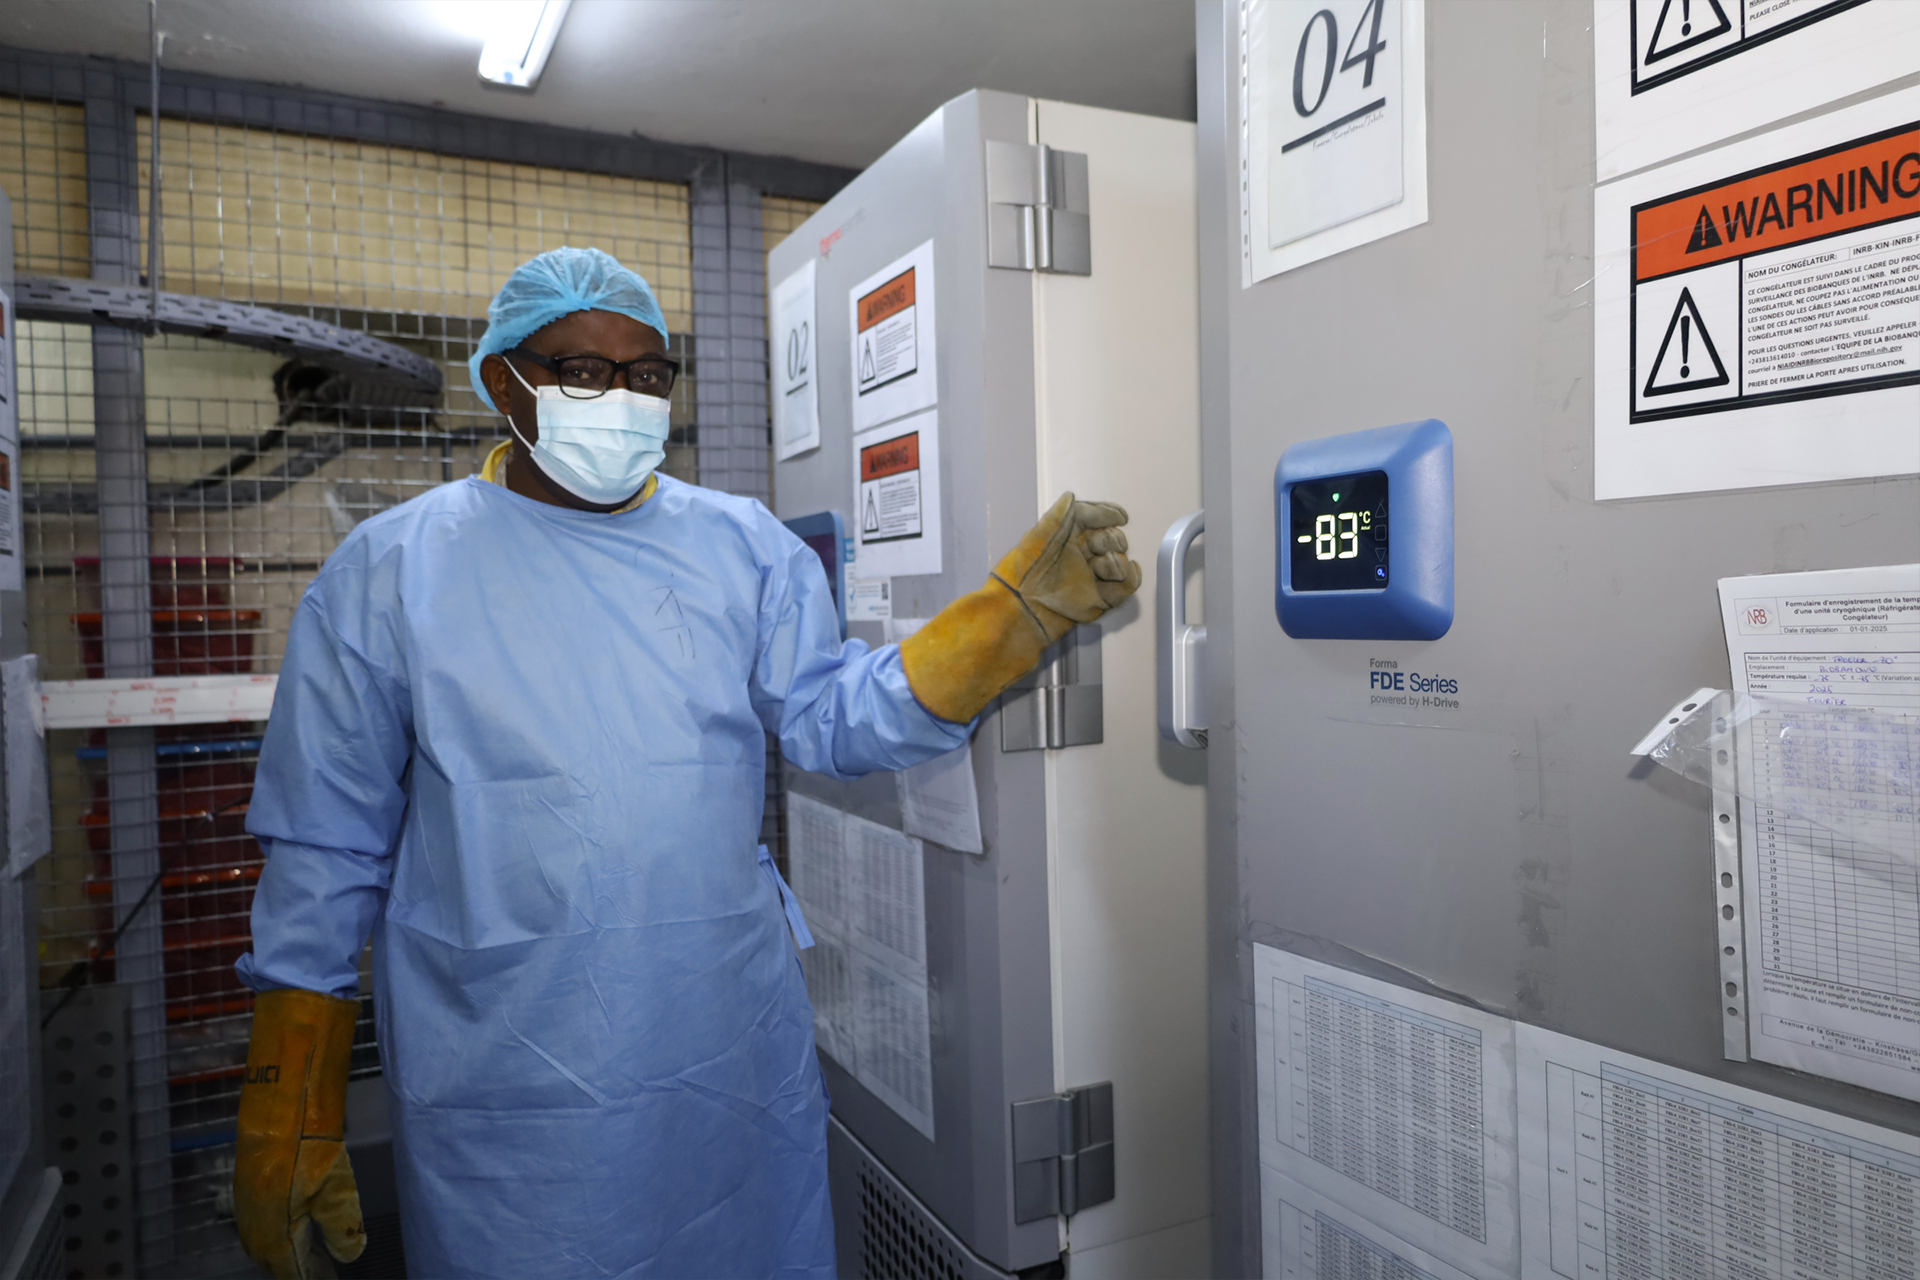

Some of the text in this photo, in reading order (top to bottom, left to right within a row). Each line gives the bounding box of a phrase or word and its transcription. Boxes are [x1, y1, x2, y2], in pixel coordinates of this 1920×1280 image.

[1292, 0, 1386, 118] 04
[1722, 151, 1920, 242] WARNING
[1748, 269, 1766, 278] NOM
[1768, 266, 1779, 274] DU
[1803, 276, 1813, 284] EST
[1815, 272, 1832, 281] SUIVI
[1834, 267, 1852, 277] DANS
[1854, 265, 1861, 273] LE
[1863, 260, 1886, 271] CADRE
[1888, 257, 1899, 266] DU
[1747, 290, 1791, 305] SURVEILLANCE
[1794, 287, 1805, 295] DES
[1807, 278, 1849, 293] BIOBANQUES
[1890, 267, 1899, 275] NE
[1805, 292, 1830, 302] COUPEZ
[1832, 289, 1845, 297] PAS
[1847, 276, 1905, 294] L'ALIMENTATION
[1907, 274, 1918, 282] OU
[1747, 324, 1764, 332] L'UNE
[1776, 319, 1787, 327] CES
[1789, 314, 1815, 324] ACTIONS
[1818, 311, 1833, 319] PEUT
[1836, 306, 1857, 316] AVOIR
[1858, 302, 1878, 312] POUR
[1759, 311, 1783, 321] SONDES
[1785, 308, 1795, 316] OU
[1796, 306, 1806, 314] LES
[1833, 297, 1850, 307] SANS
[1852, 292, 1880, 303] ACCORD
[1747, 347, 1764, 355] POUR
[1778, 338, 1813, 351] QUESTIONS
[1853, 326, 1883, 337] VEUILLEZ
[1886, 321, 1916, 332] APPELER
[1804, 323, 1817, 331] SOIT
[788, 320, 808, 381] 02
[1800, 345, 1829, 356] contacter
[1863, 338, 1871, 346] DE
[1747, 365, 1770, 374] courriel
[1779, 373, 1804, 383] FERMER
[1815, 369, 1835, 377] PORTE
[1822, 598, 1881, 606] d'enregistrement
[1842, 613, 1888, 621] Congélateur)
[1370, 658, 1398, 668] Forma
[1370, 672, 1458, 694] FDE Series
[1370, 694, 1459, 709] powered by H-Drive
